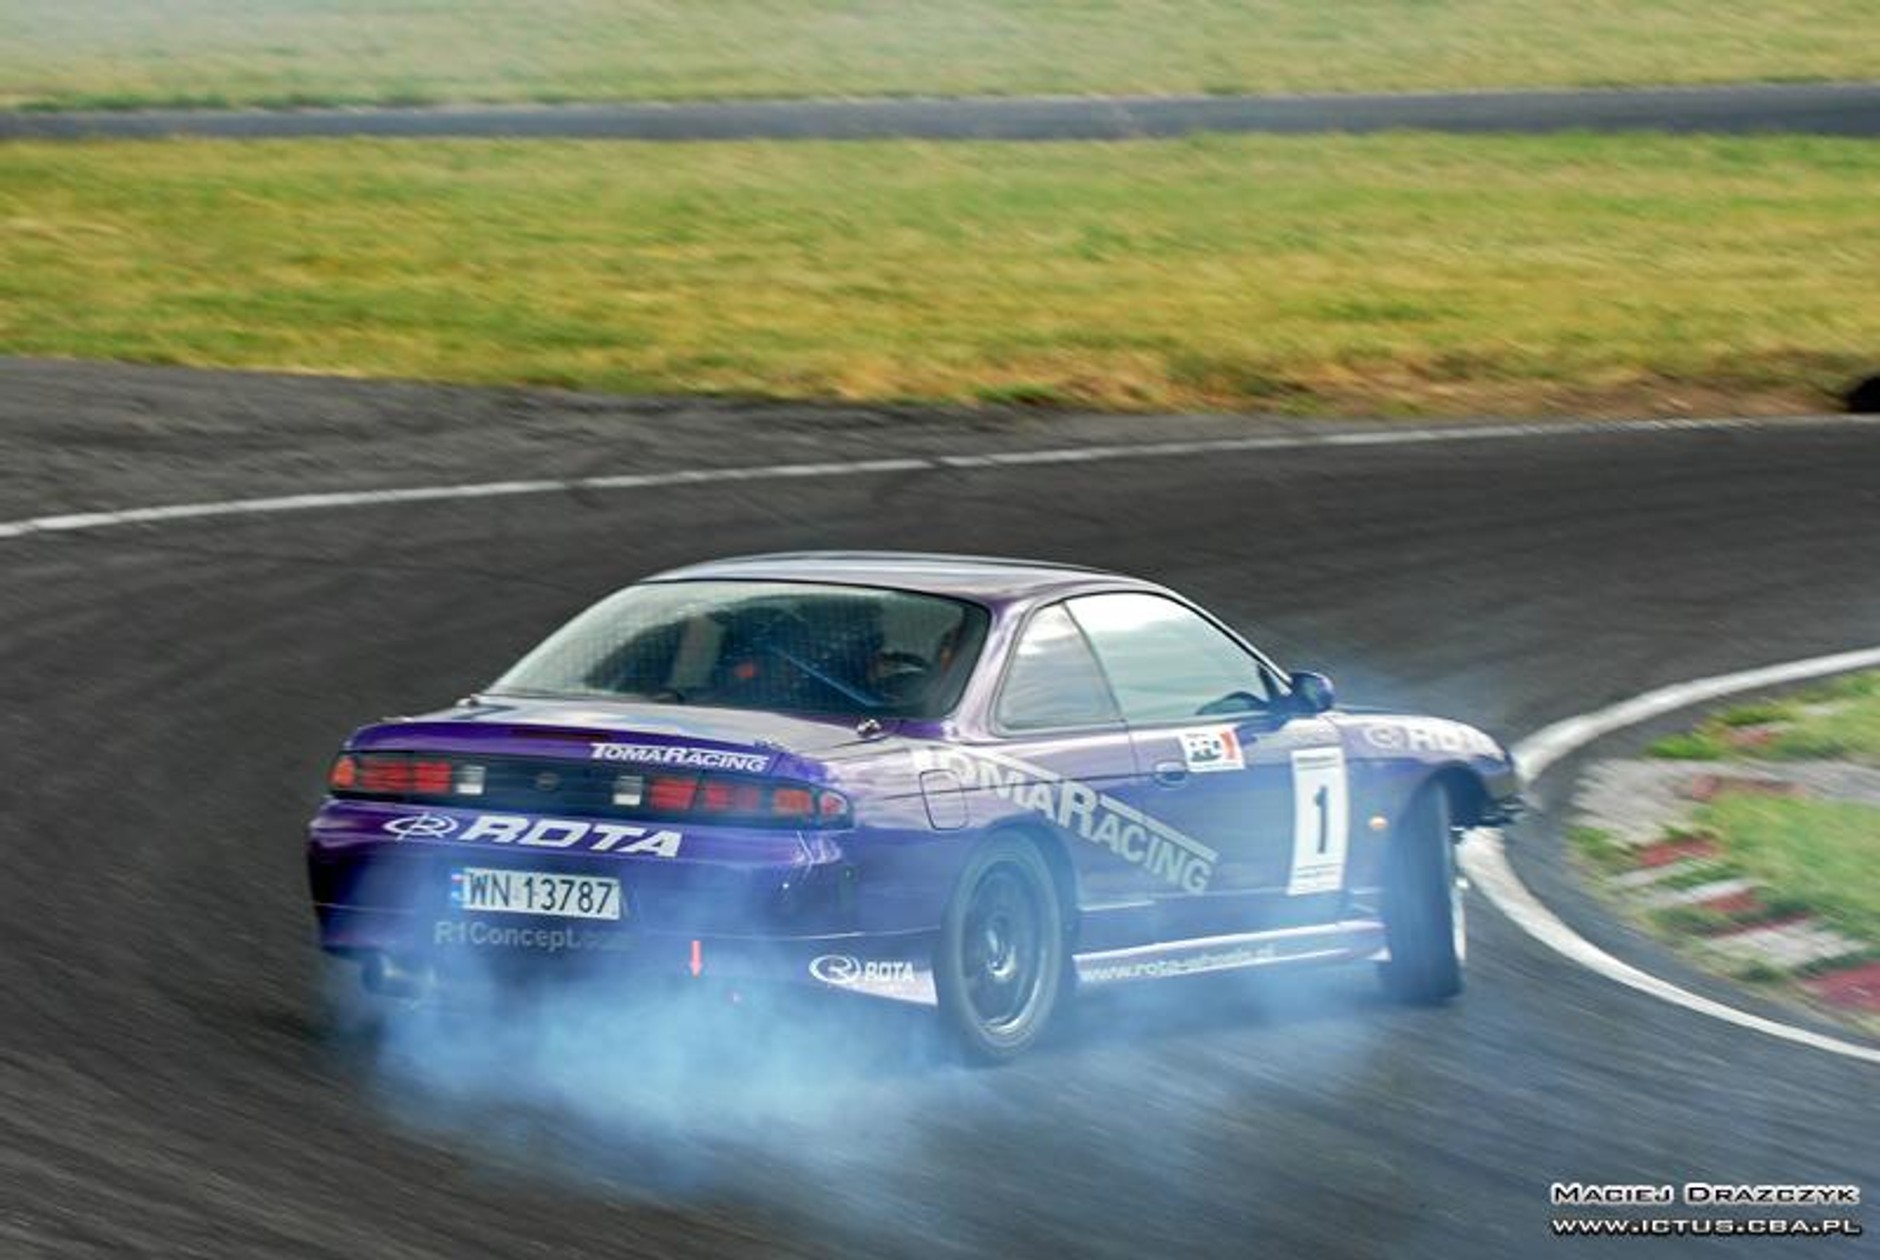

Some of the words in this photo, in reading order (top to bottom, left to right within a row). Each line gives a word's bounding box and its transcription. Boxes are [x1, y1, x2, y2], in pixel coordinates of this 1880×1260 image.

[457, 815, 683, 857] ROTA
[1312, 784, 1329, 856] 1
[468, 871, 512, 907] WN
[523, 879, 613, 915] 13787
[865, 961, 914, 982] ROTA
